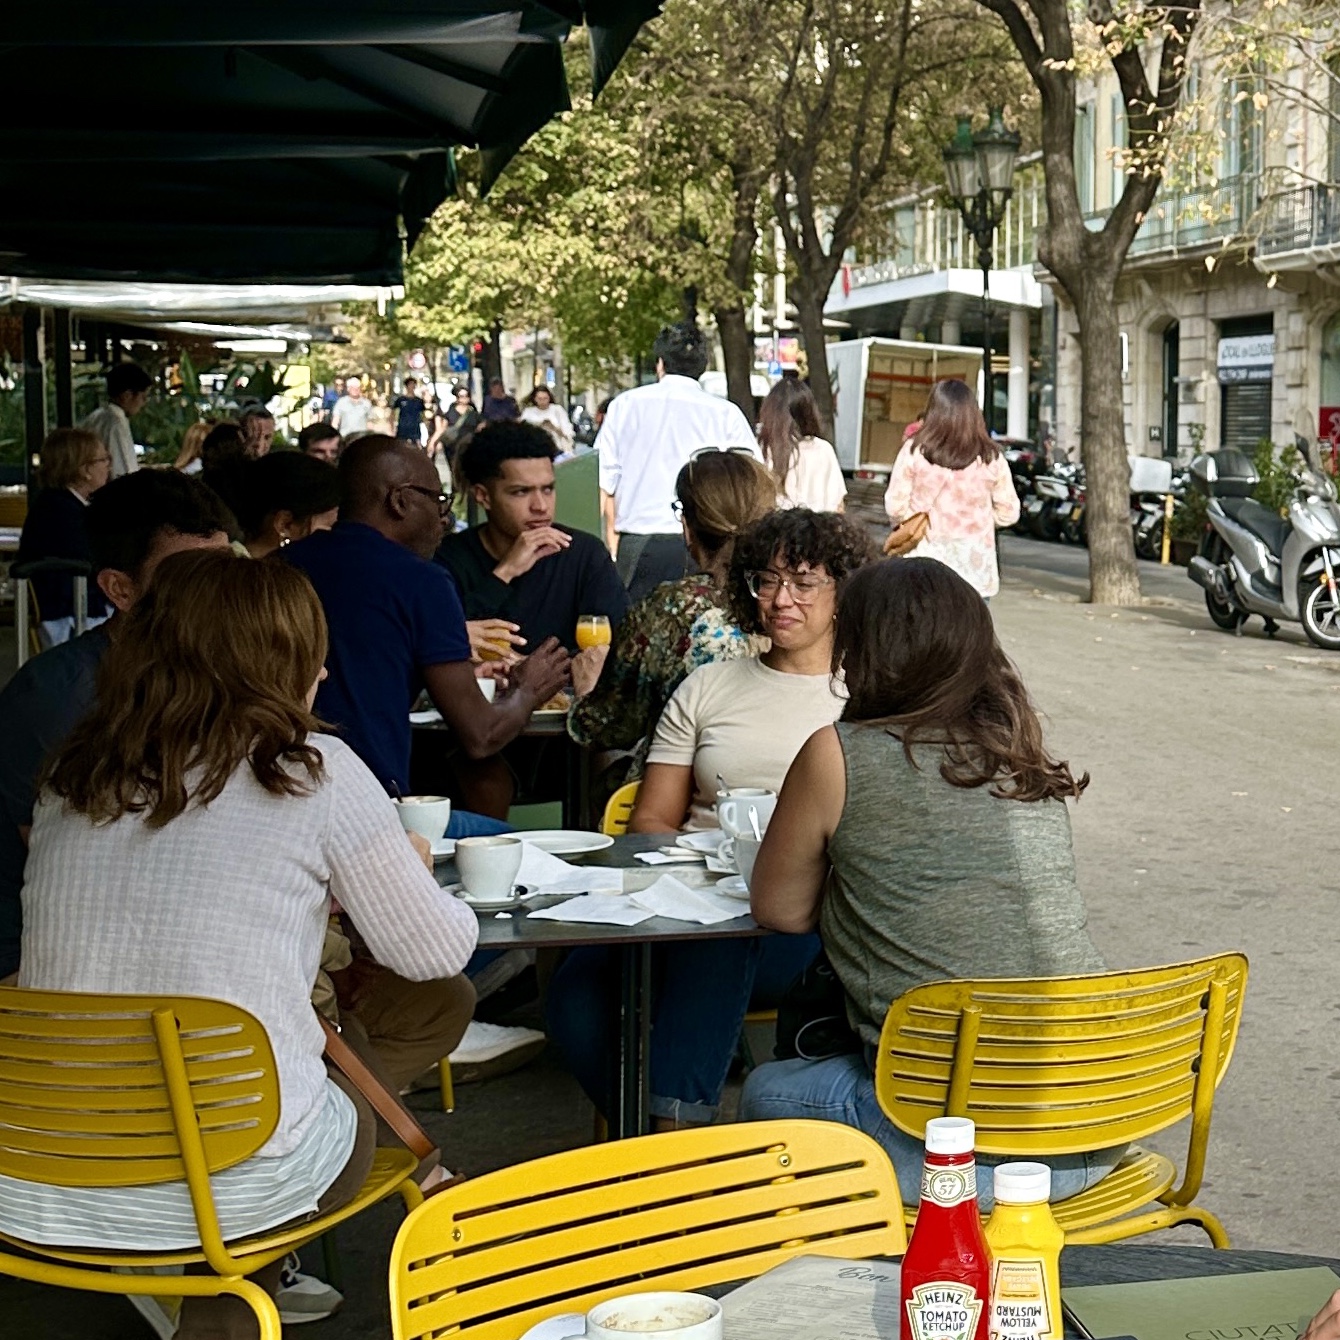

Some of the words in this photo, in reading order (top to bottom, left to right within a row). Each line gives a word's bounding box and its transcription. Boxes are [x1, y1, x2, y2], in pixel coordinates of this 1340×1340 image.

[938, 1184, 956, 1196] 57
[838, 1266, 895, 1283] Bon
[925, 1291, 964, 1305] HEINZ
[920, 1310, 968, 1322] TOMATO
[996, 1305, 1042, 1317] MUSTARD
[923, 1322, 965, 1331] KETCHUP
[1000, 1317, 1037, 1328] YELLOW
[1185, 1322, 1298, 1340] CIUTAT
